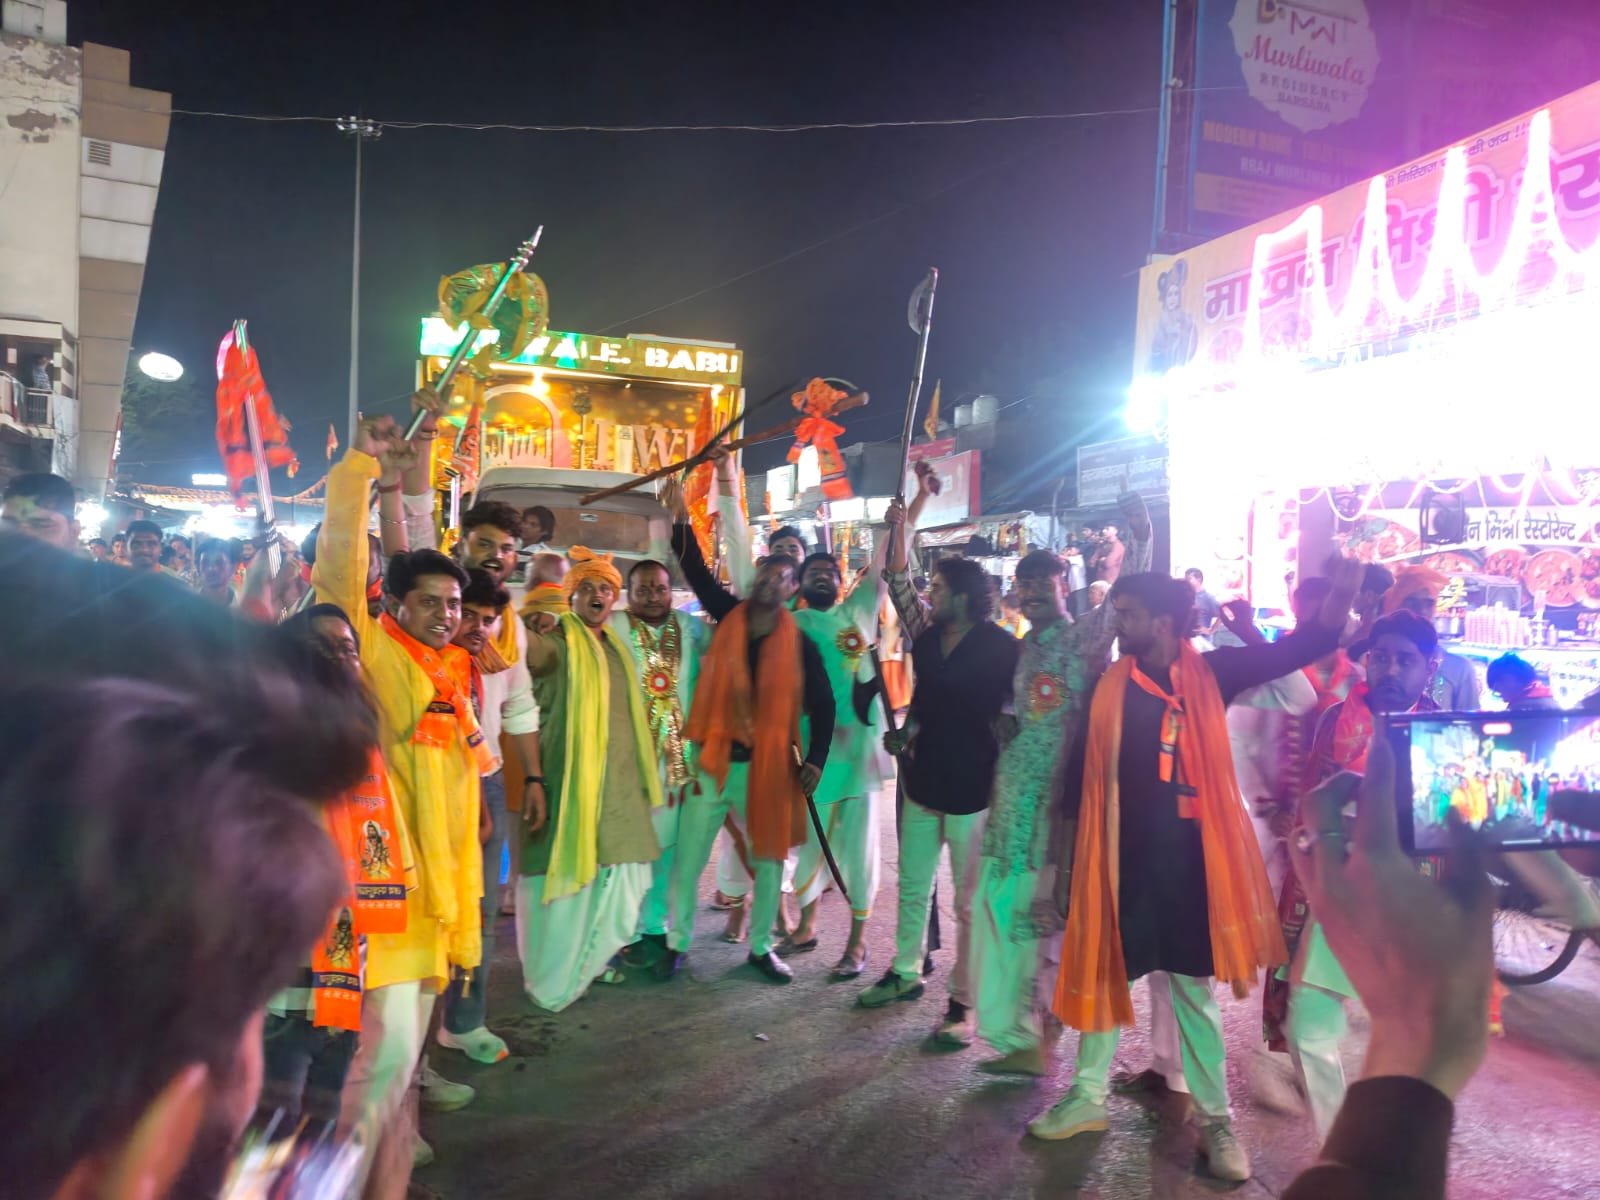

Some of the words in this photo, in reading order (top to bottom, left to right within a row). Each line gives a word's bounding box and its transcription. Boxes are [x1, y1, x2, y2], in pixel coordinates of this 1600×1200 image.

[1244, 34, 1365, 85] Murliwala
[1259, 71, 1352, 103] RESIDENCY
[644, 346, 739, 373] BABU
